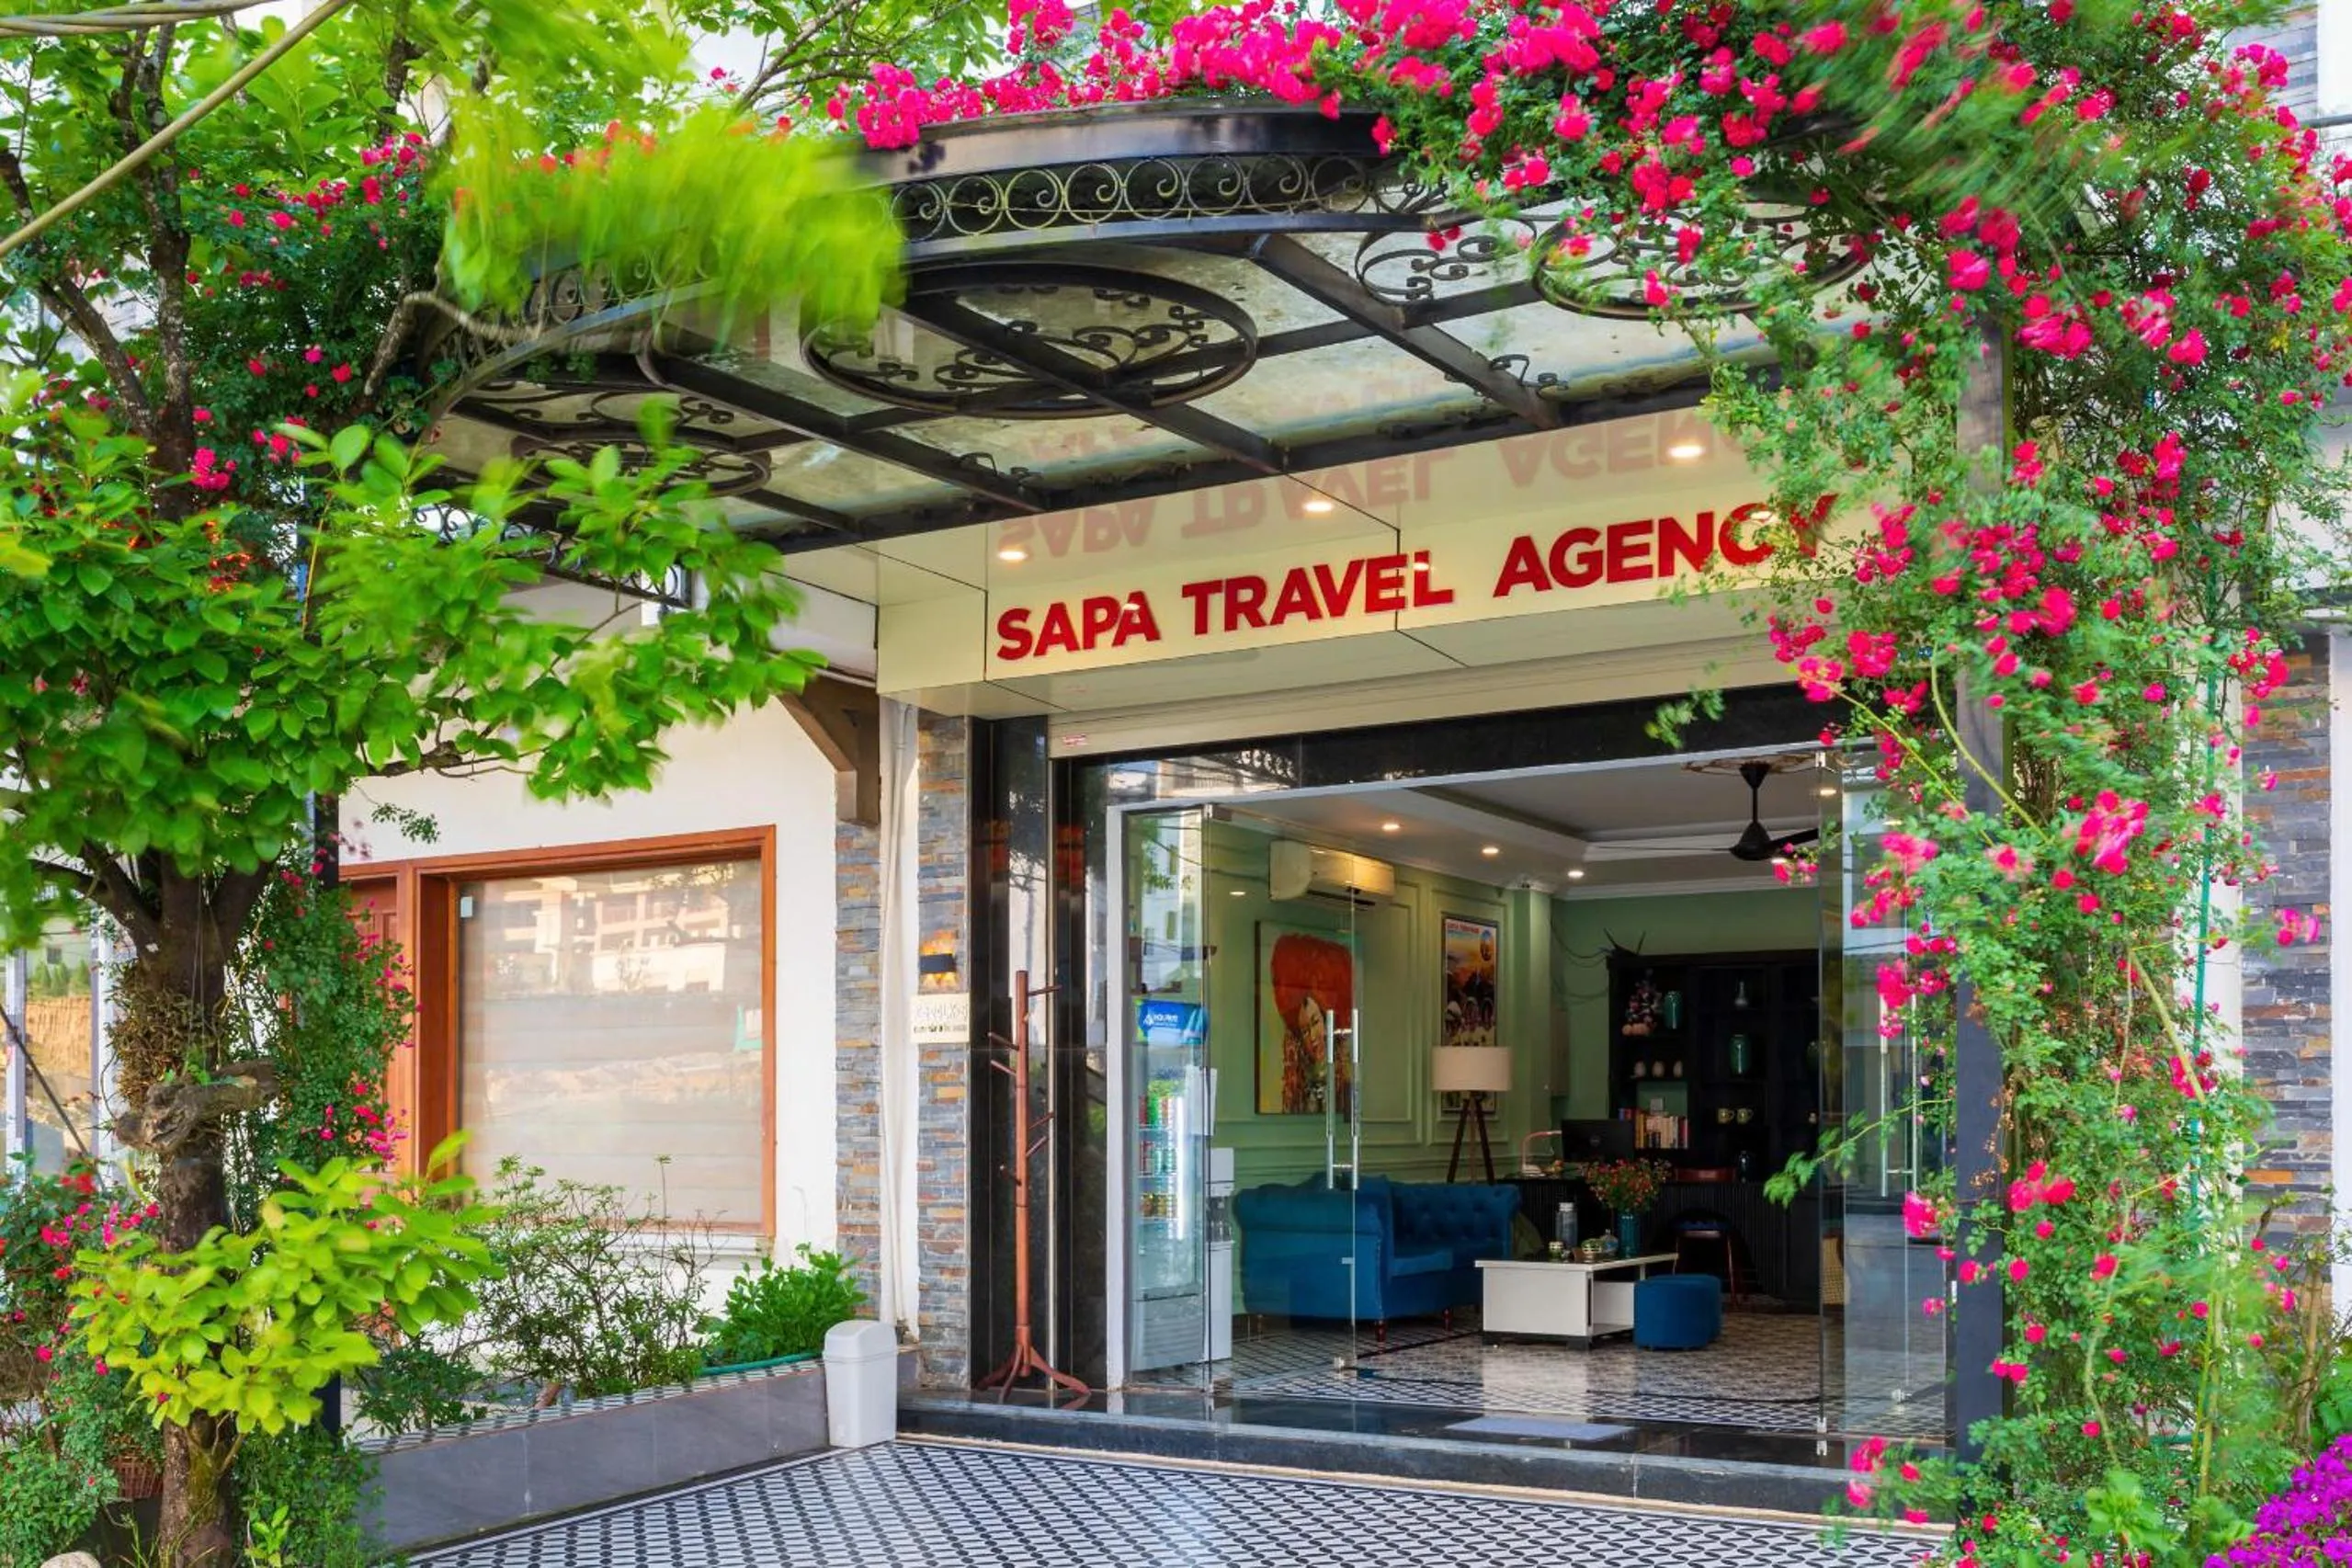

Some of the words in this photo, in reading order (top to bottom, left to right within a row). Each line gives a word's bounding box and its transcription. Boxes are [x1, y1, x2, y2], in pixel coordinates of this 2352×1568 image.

[996, 590, 1162, 661] SAPA
[1182, 550, 1454, 635] TRAVEL
[1493, 493, 1838, 598] AGENCY
